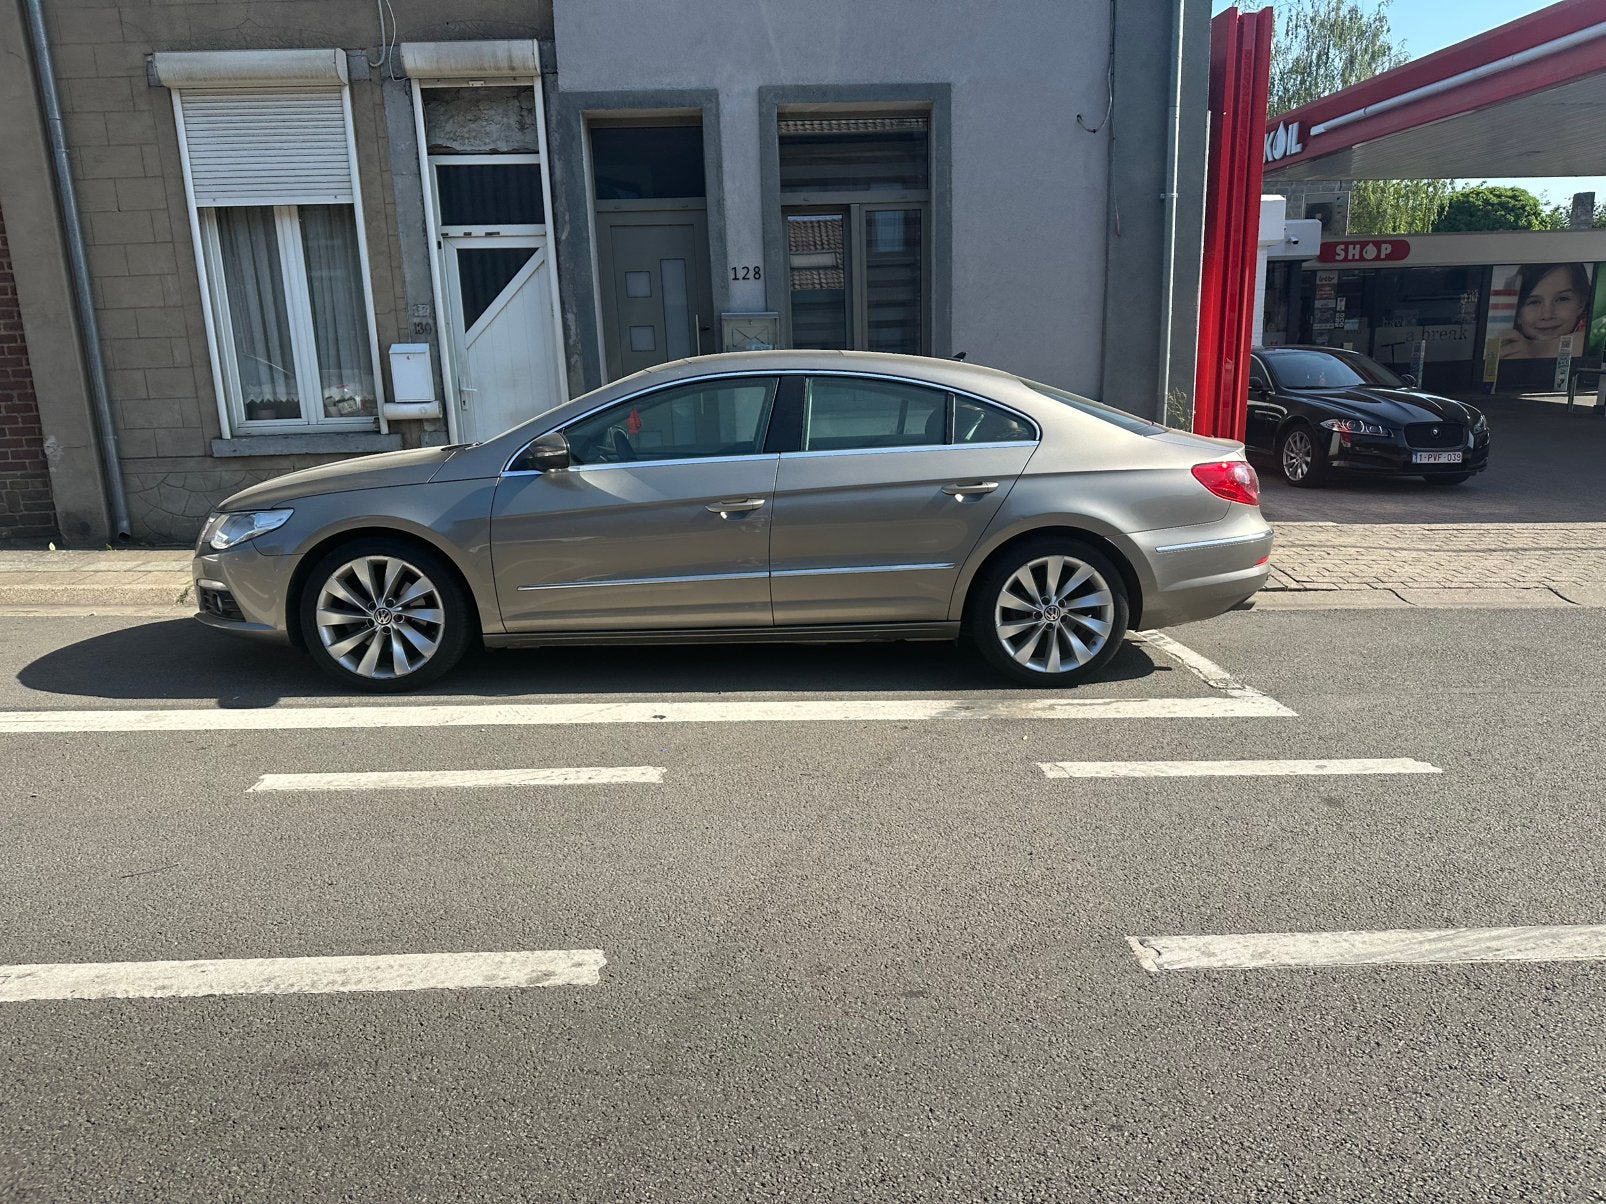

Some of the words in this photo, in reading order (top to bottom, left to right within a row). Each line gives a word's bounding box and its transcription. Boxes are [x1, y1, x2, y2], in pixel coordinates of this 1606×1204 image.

[1335, 242, 1392, 261] SHOP
[731, 266, 762, 281] 128
[413, 322, 432, 335] 130
[1418, 453, 1461, 463] 1-PVF-039
